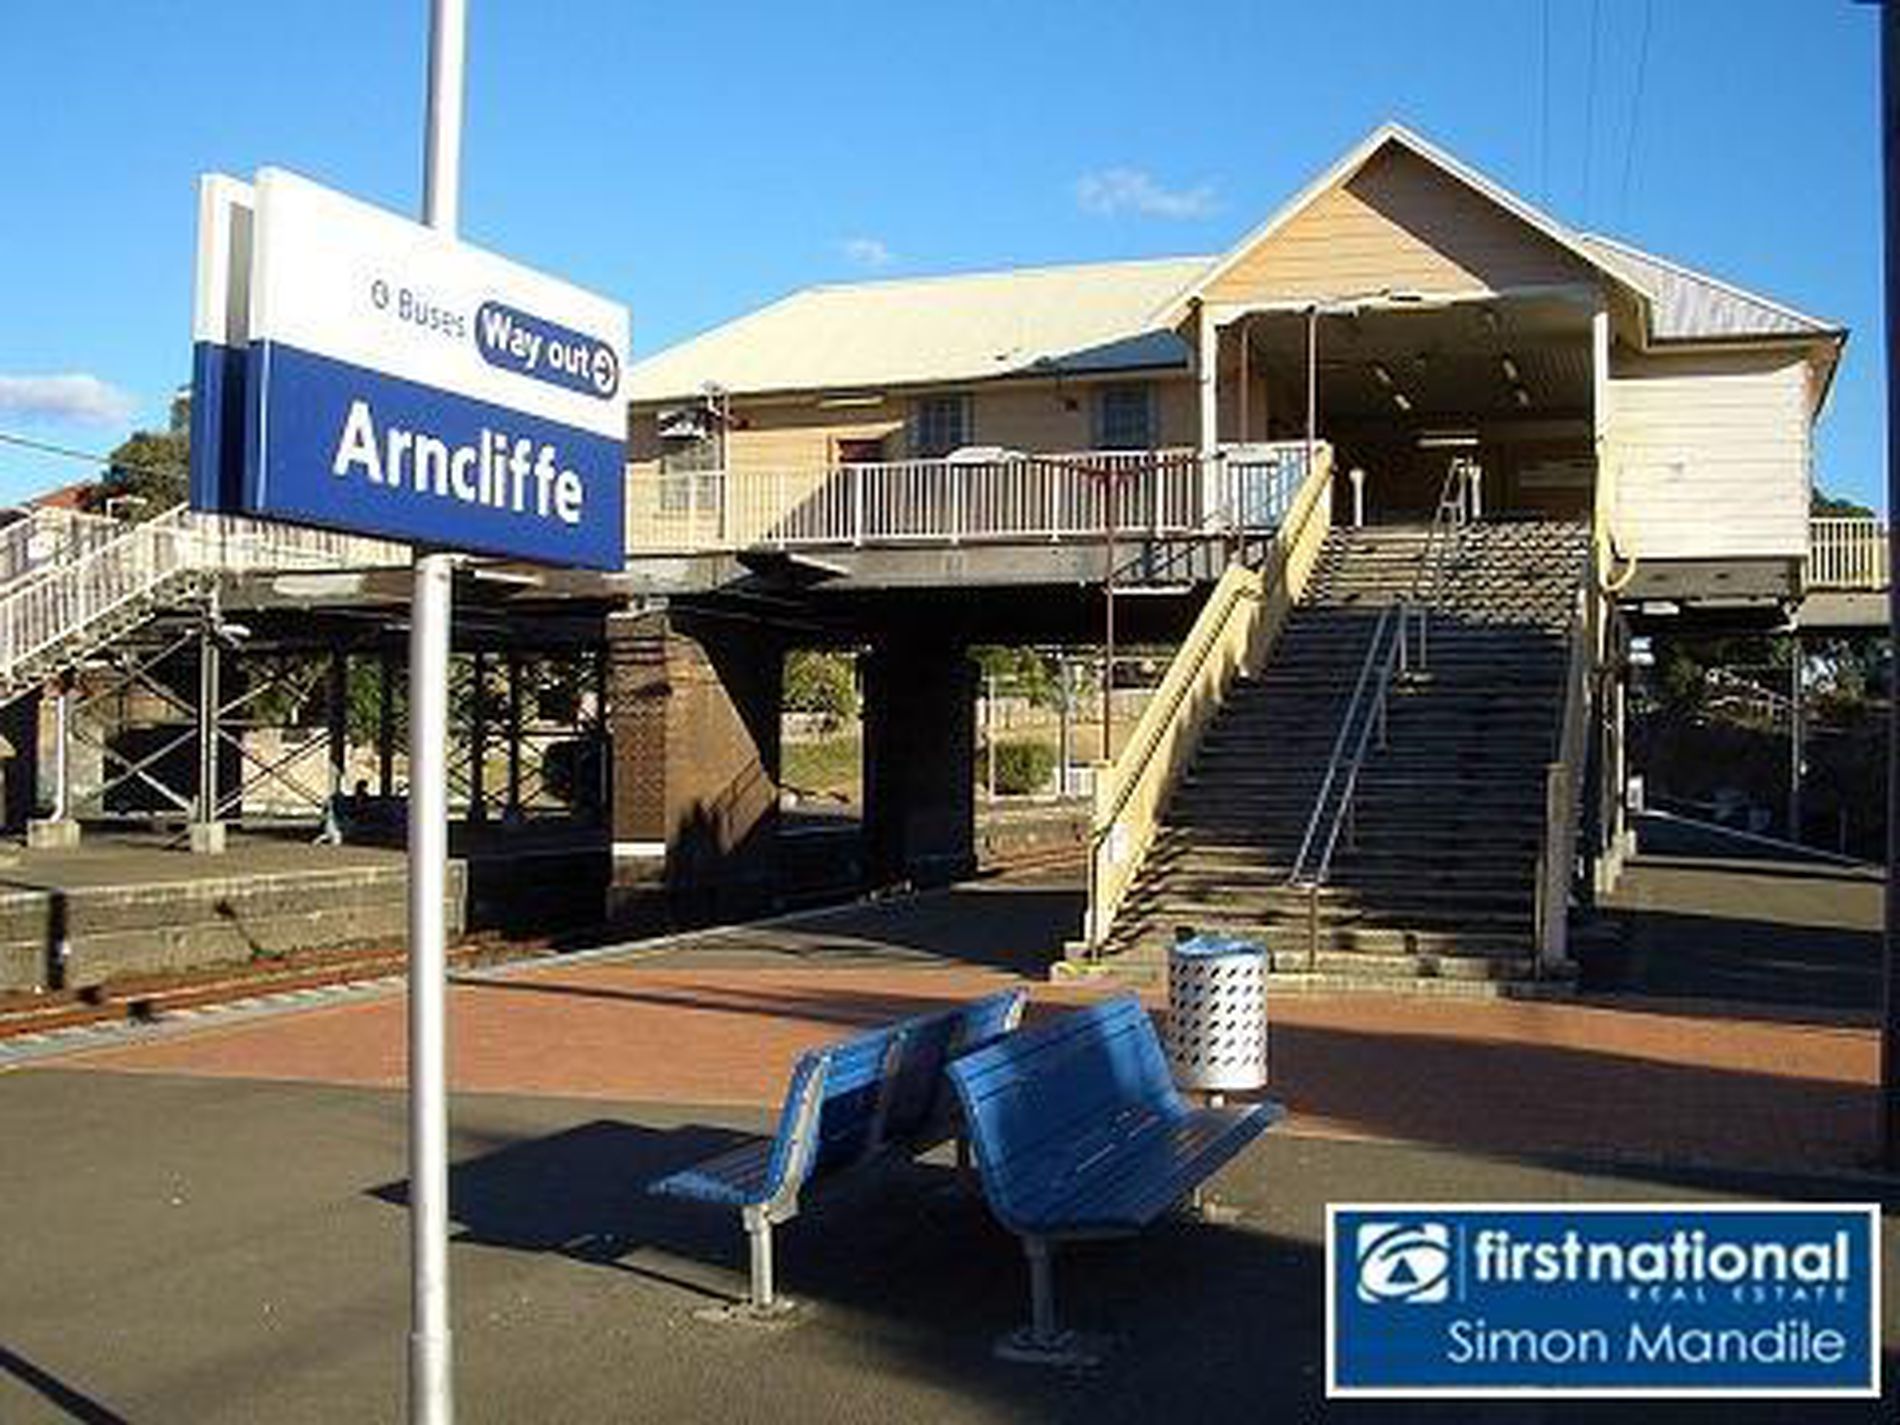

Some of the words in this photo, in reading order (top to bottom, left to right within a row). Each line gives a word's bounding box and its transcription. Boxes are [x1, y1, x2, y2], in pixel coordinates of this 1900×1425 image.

[398, 288, 466, 338] Buses
[481, 306, 542, 369] Way
[547, 342, 590, 379] out
[332, 399, 584, 524] Arncliffe
